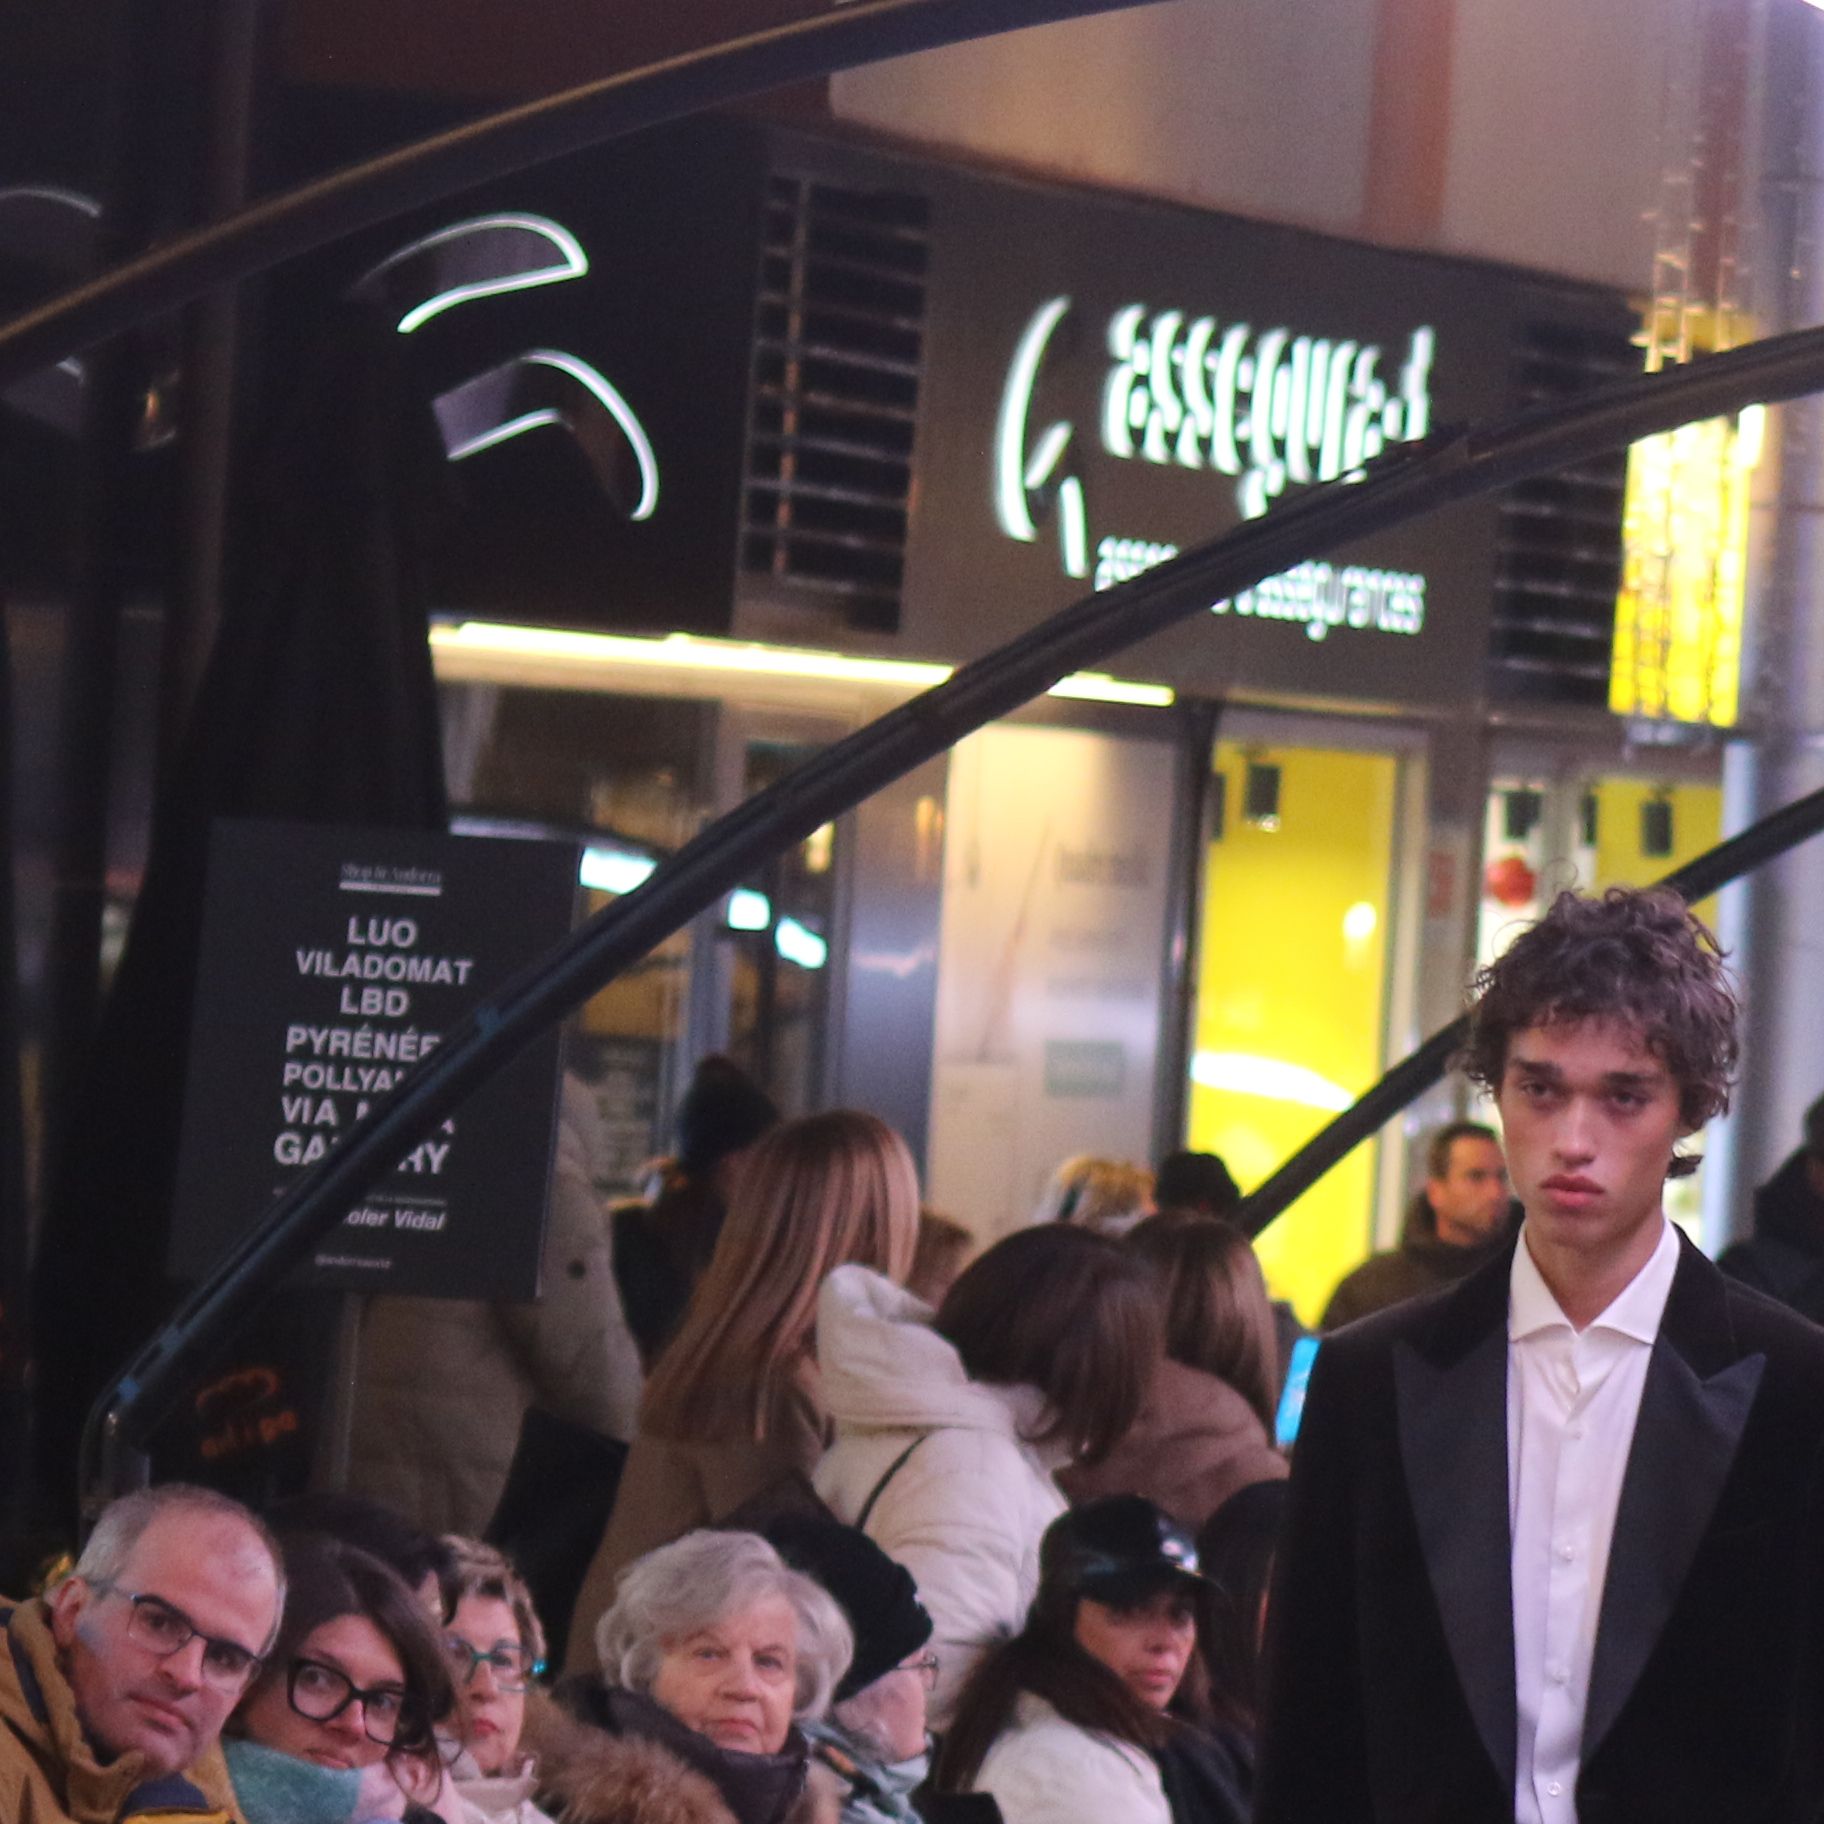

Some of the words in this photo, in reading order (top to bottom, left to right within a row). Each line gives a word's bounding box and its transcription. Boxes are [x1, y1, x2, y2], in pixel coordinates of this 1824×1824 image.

[347, 916, 418, 947] LUO
[296, 950, 474, 985] VILADOMAT
[340, 985, 411, 1017] LBD
[283, 1062, 405, 1092] POLLYA
[281, 1097, 338, 1126] VIA
[343, 1207, 389, 1227] oler
[394, 1209, 447, 1231] Vidal
